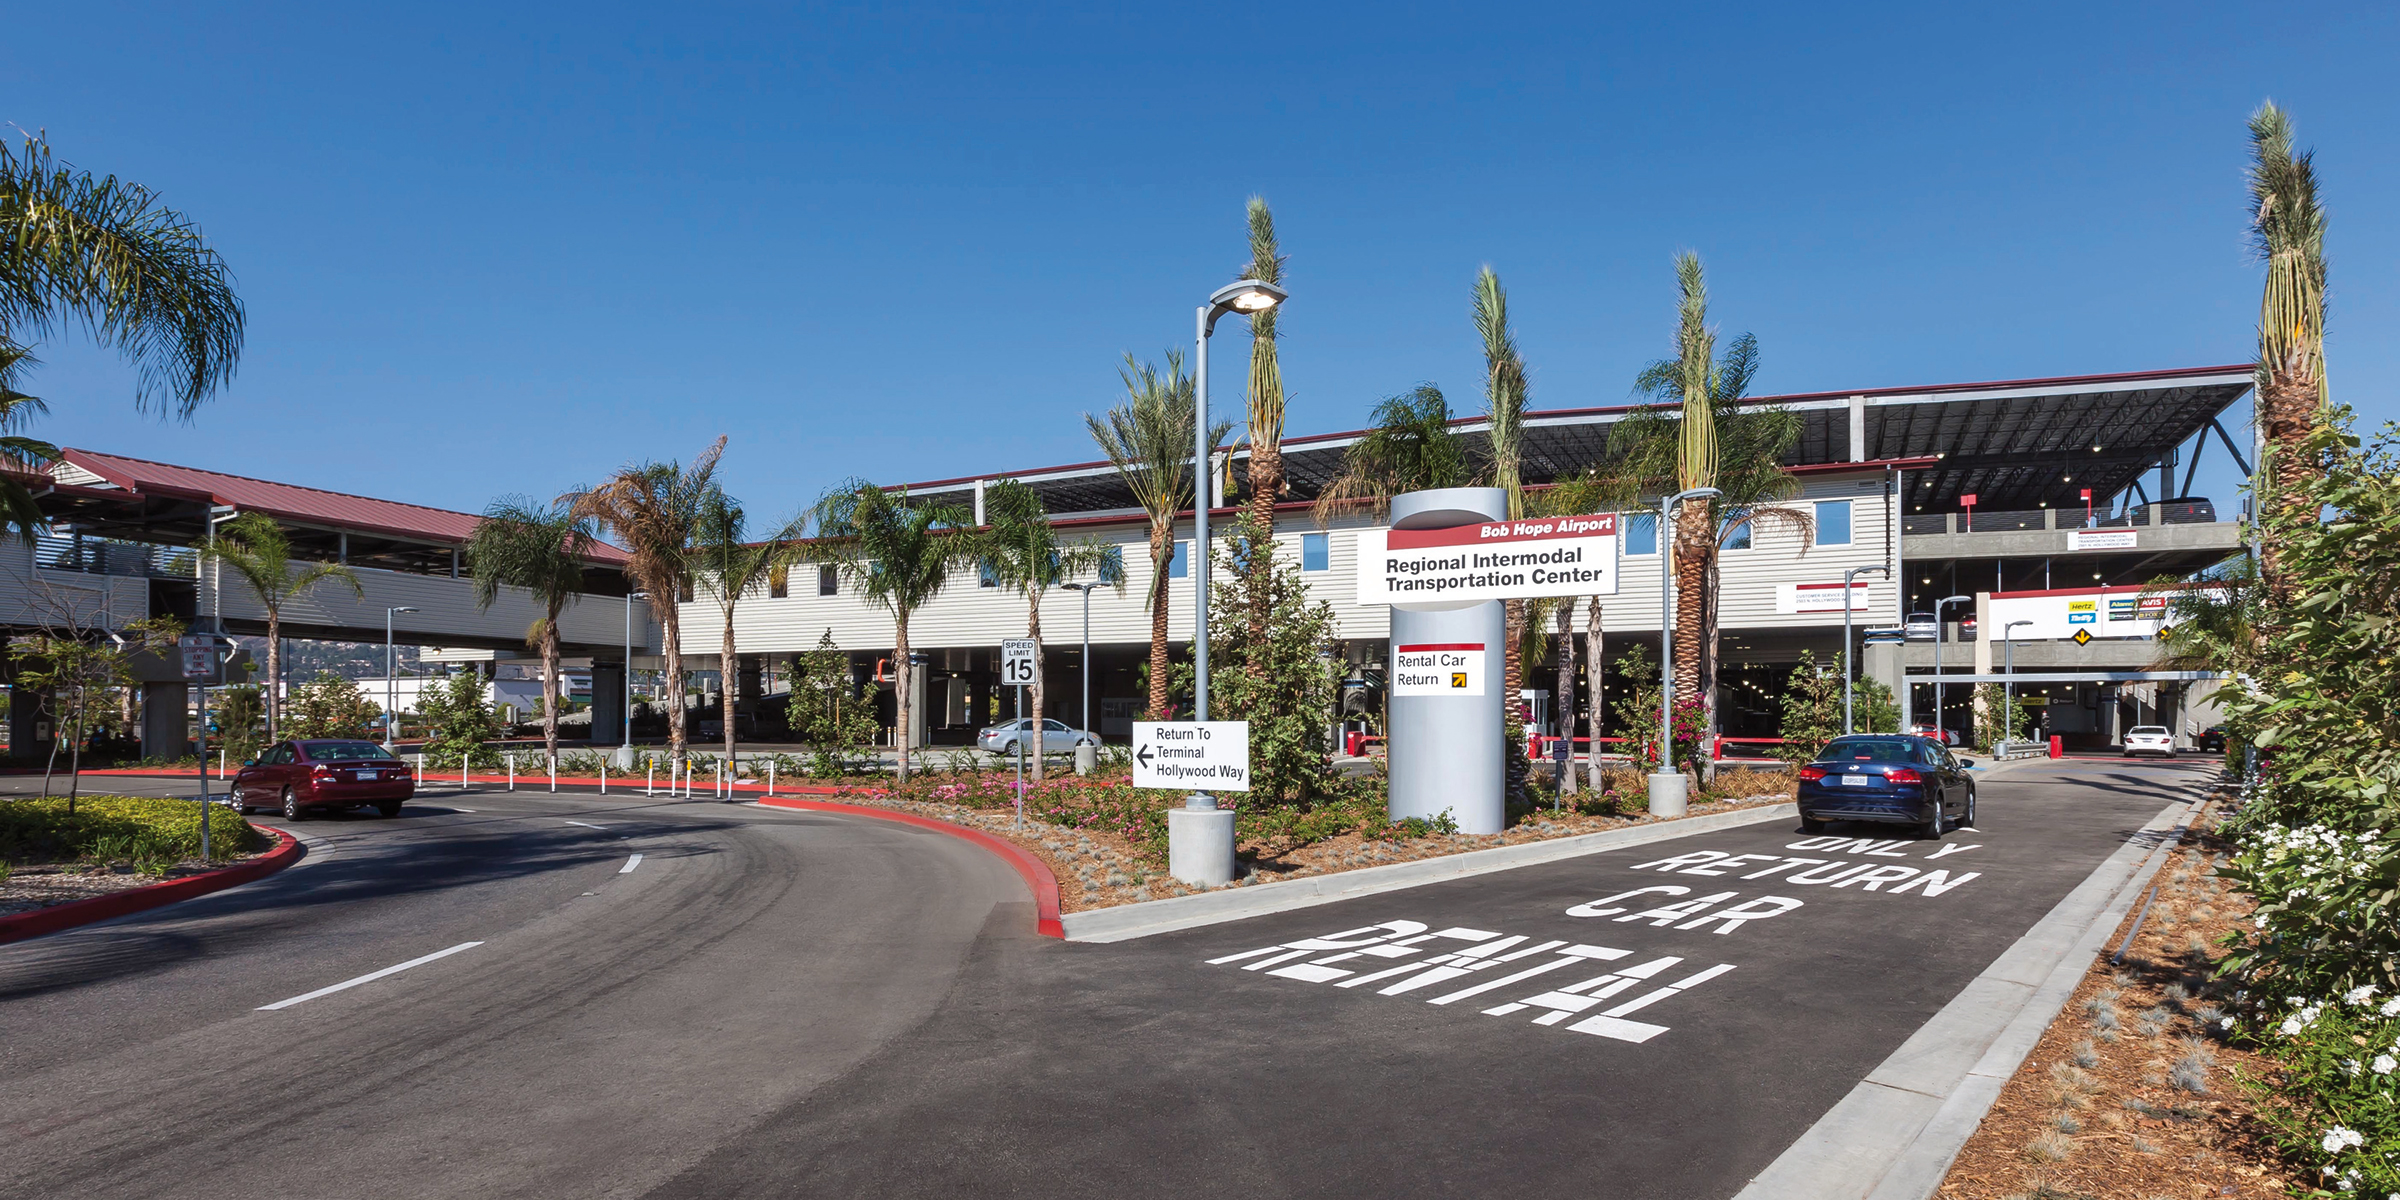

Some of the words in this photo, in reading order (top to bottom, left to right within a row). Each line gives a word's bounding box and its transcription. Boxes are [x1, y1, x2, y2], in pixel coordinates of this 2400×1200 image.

[1480, 525, 1509, 538] Bob
[1513, 522, 1553, 537] Hope
[1556, 517, 1613, 533] Airport
[1386, 554, 1466, 575] Regional
[1473, 547, 1582, 568] Intermodal
[1386, 571, 1524, 592] Transportation
[1532, 568, 1602, 585] Center
[1006, 659, 1033, 680] 15
[1398, 654, 1436, 667] Rental
[1440, 654, 1467, 666] Car
[1398, 673, 1439, 686] Return
[1156, 727, 1194, 740] Return
[1197, 727, 1211, 740] To
[1156, 745, 1205, 758] Terminal
[1156, 764, 1216, 779] Hollywood
[1219, 765, 1244, 781] Way
[1785, 827, 1984, 860] ONLY
[1629, 850, 1983, 898] RETURN
[1565, 885, 1804, 935] CAR
[1204, 919, 1738, 1043] RENTAL
